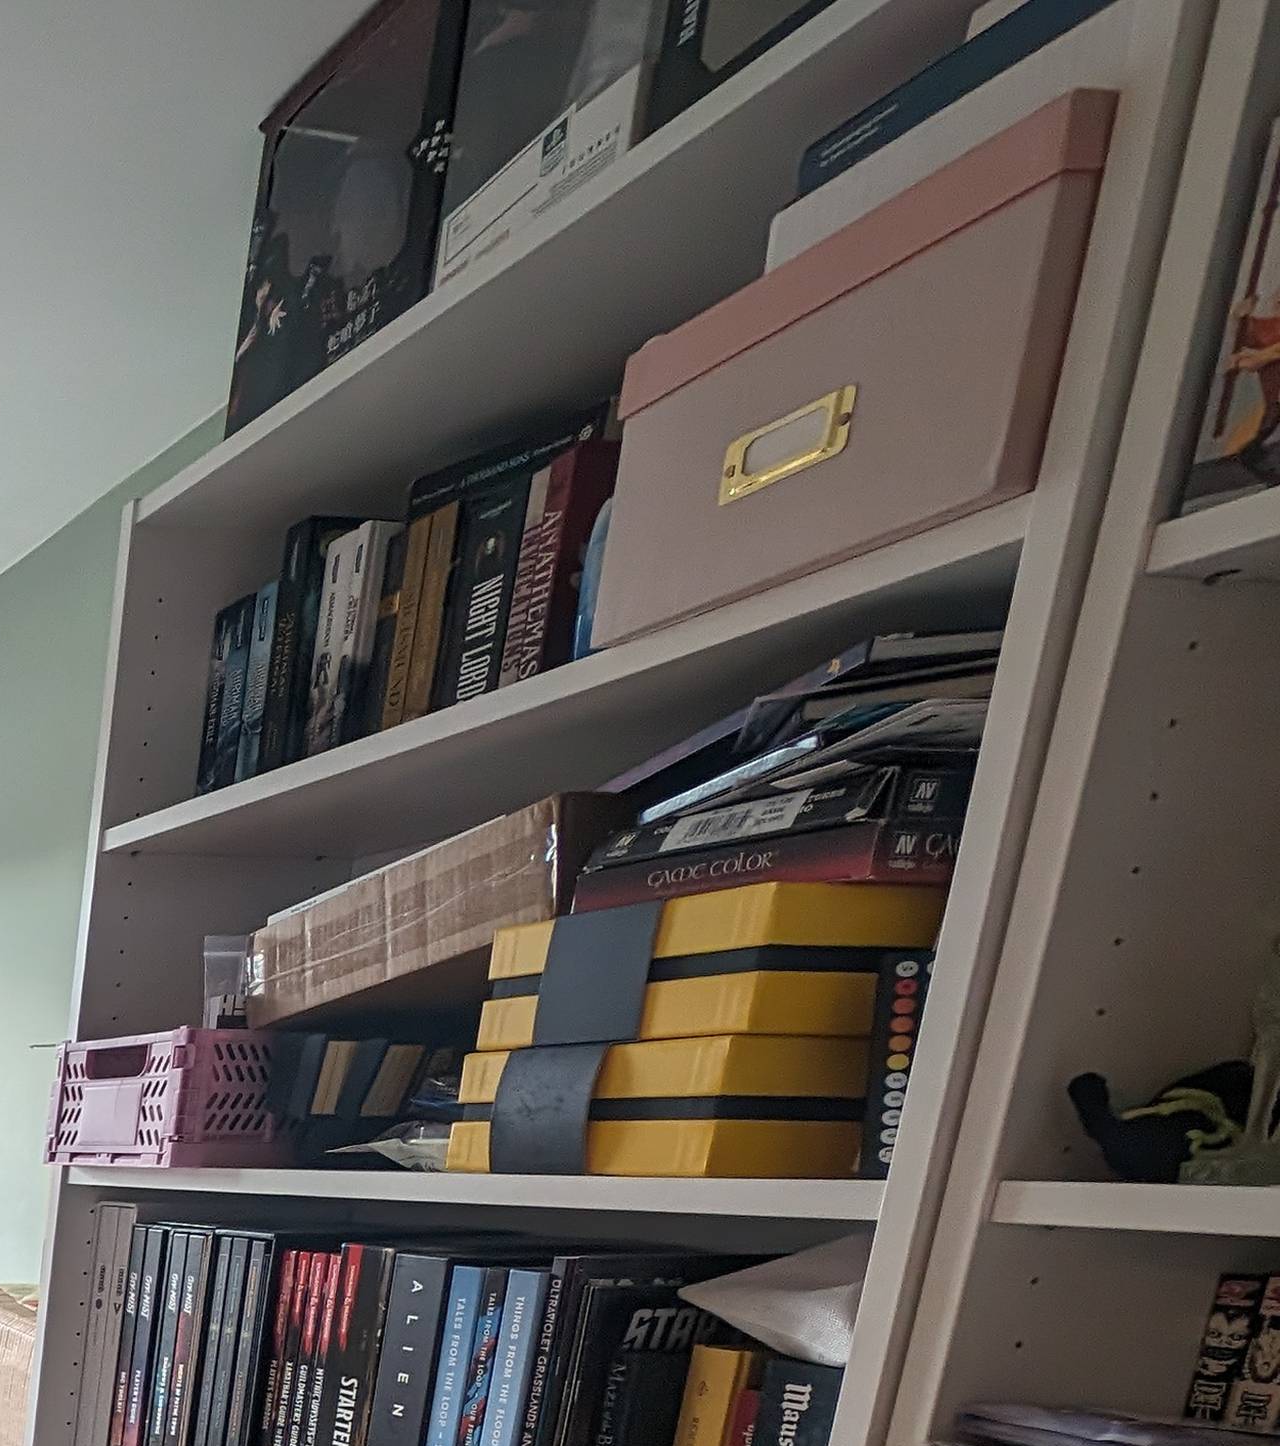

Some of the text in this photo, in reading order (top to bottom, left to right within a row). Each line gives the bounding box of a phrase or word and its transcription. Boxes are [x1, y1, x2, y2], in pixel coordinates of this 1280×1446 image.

[465, 573, 505, 642] NIGHT
[520, 510, 563, 680] ANATHEMAS
[709, 850, 776, 878] COLOR
[453, 1297, 465, 1330] TALES
[509, 1295, 526, 1340] THINGS
[481, 1319, 491, 1343] FROM
[391, 1279, 425, 1418] ALIEN
[447, 1334, 459, 1367] FROM
[478, 1346, 487, 1362] THE
[502, 1344, 516, 1378] FROM
[443, 1371, 453, 1391] THE
[497, 1383, 509, 1404] THE
[523, 1355, 549, 1429] GRASSLANDS
[276, 1405, 286, 1426] GUIDE
[437, 1396, 449, 1427] LOOP
[489, 1408, 505, 1446] FLOOD
